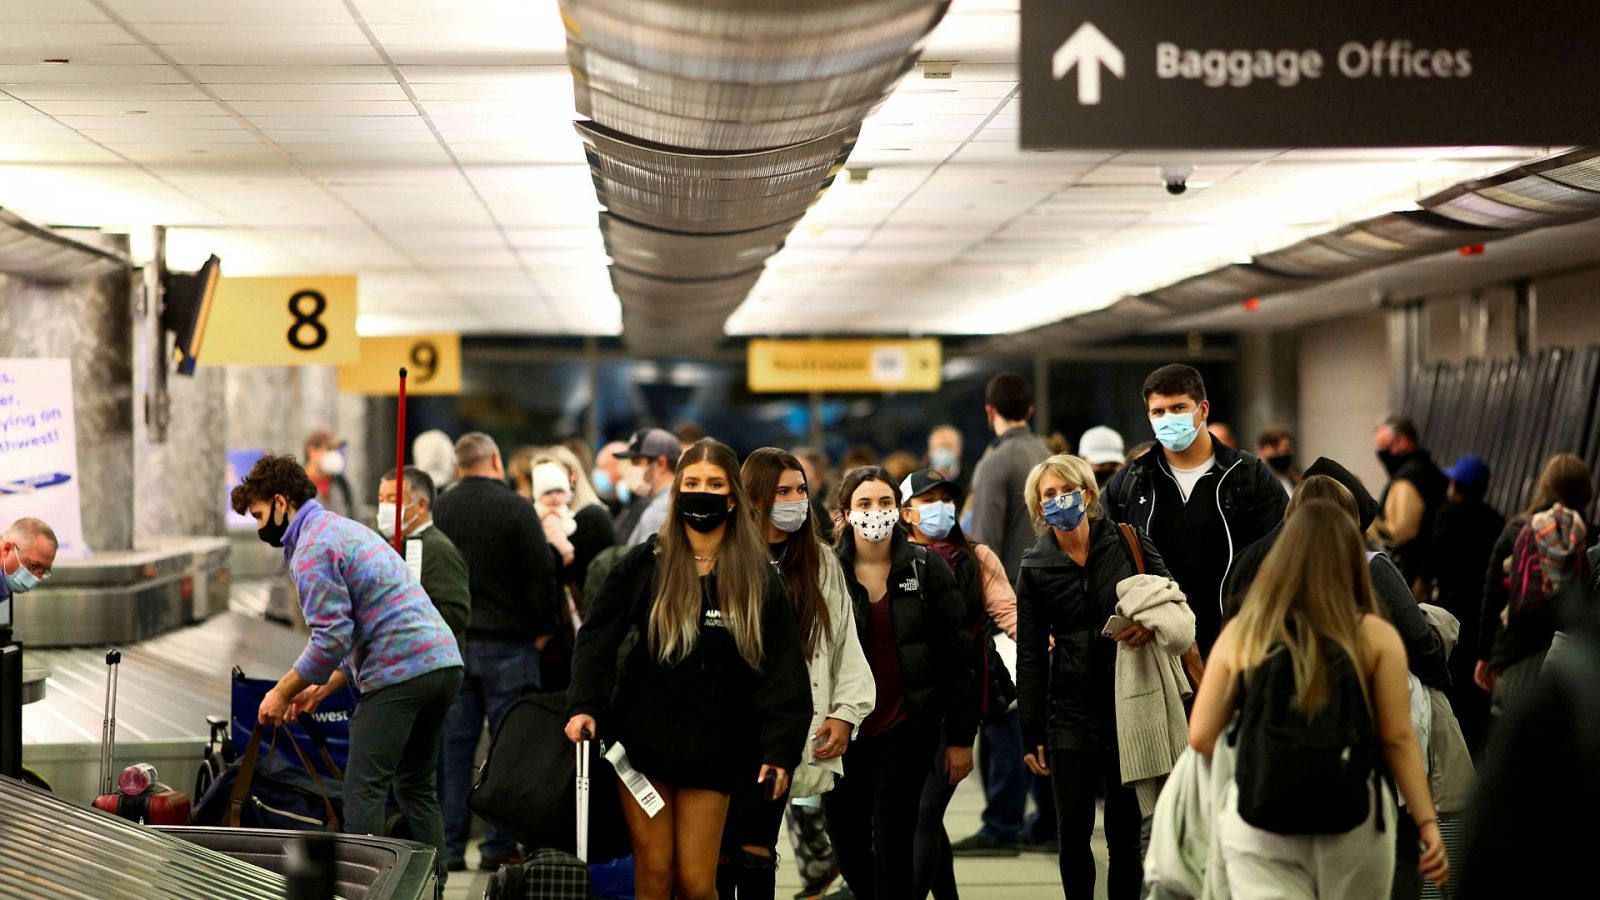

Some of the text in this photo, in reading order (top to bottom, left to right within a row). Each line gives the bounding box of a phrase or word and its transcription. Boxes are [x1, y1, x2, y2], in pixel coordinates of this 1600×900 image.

[1156, 39, 1473, 87] Baggage Offices
[287, 289, 327, 351] 8
[410, 340, 438, 384] 9
[41, 408, 62, 421] on
